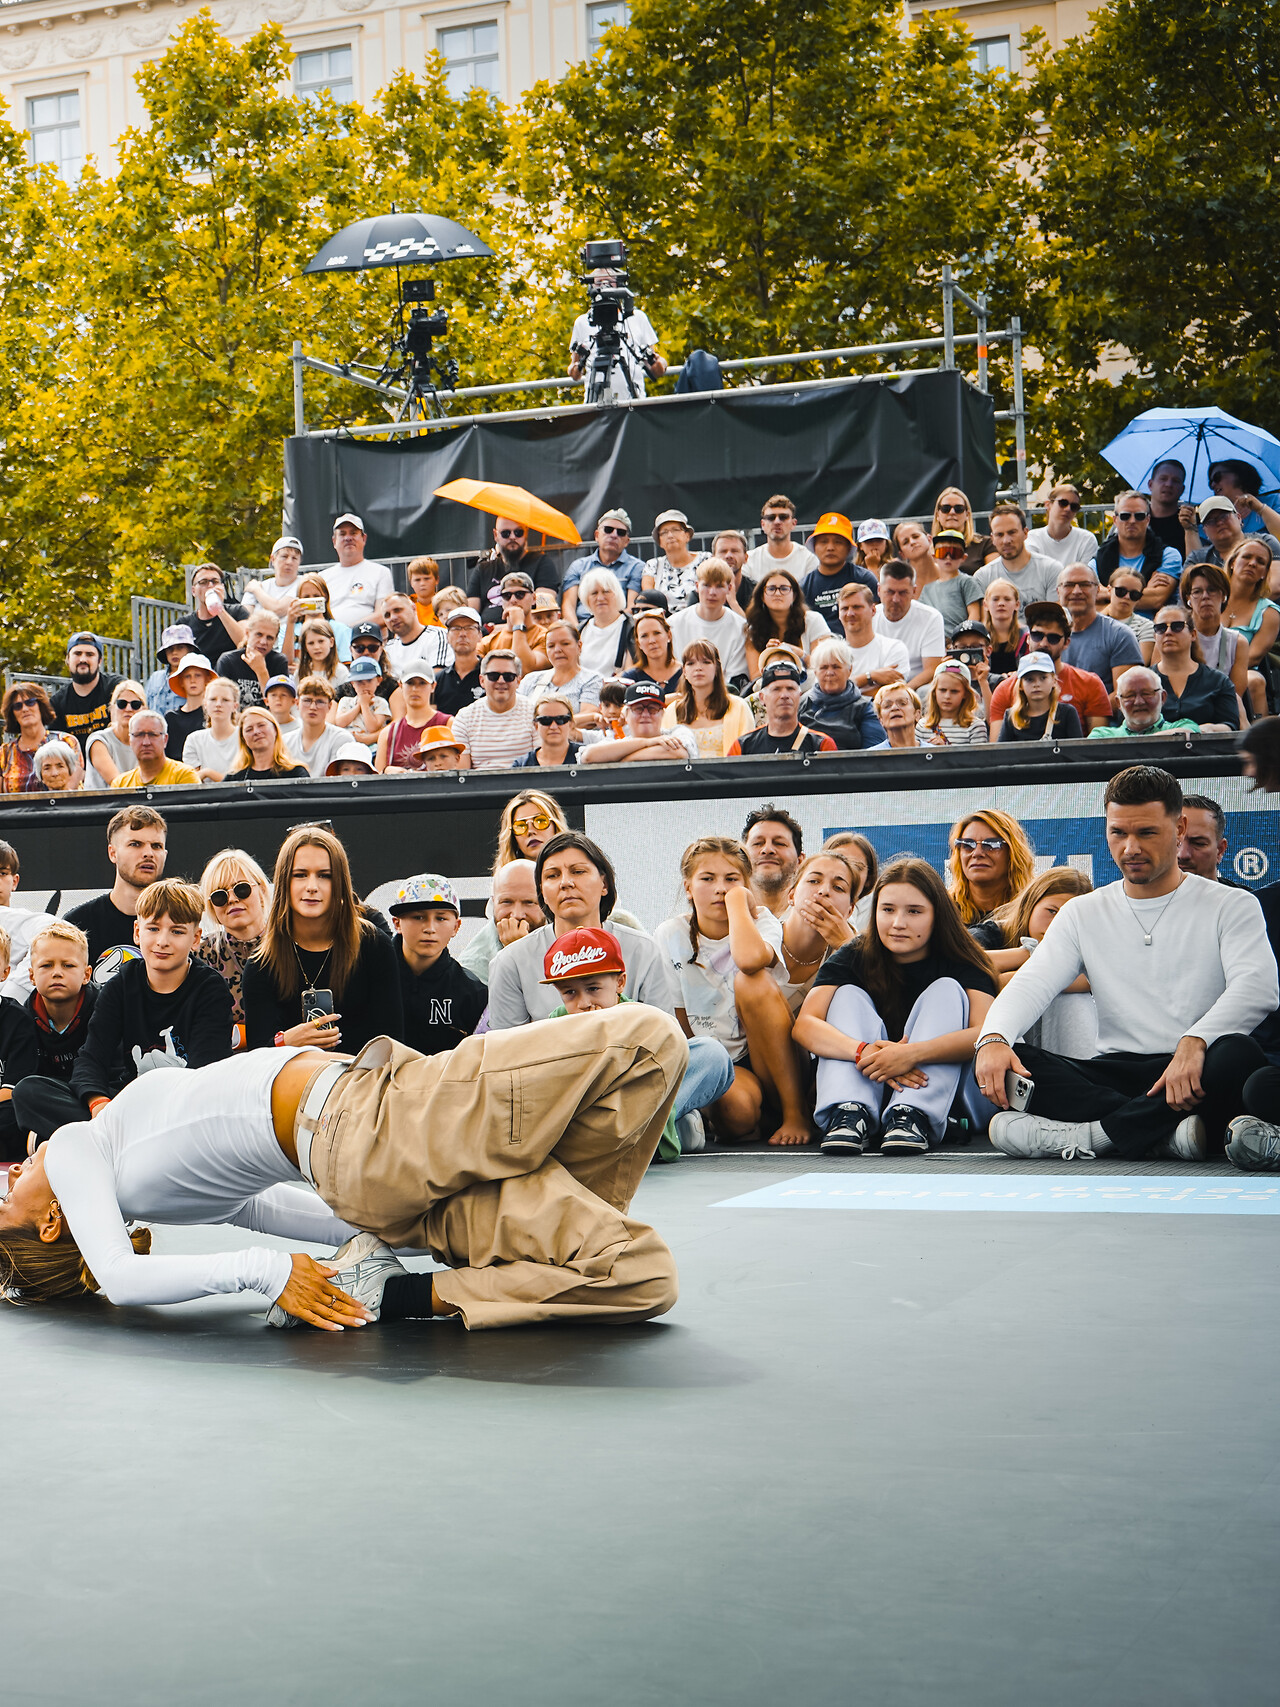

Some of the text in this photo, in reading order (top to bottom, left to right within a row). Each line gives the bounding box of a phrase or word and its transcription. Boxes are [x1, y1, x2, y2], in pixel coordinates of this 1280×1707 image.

[551, 946, 607, 976] Brooklyn
[429, 998, 453, 1025] N
[778, 1189, 1273, 1201] schauinsland
